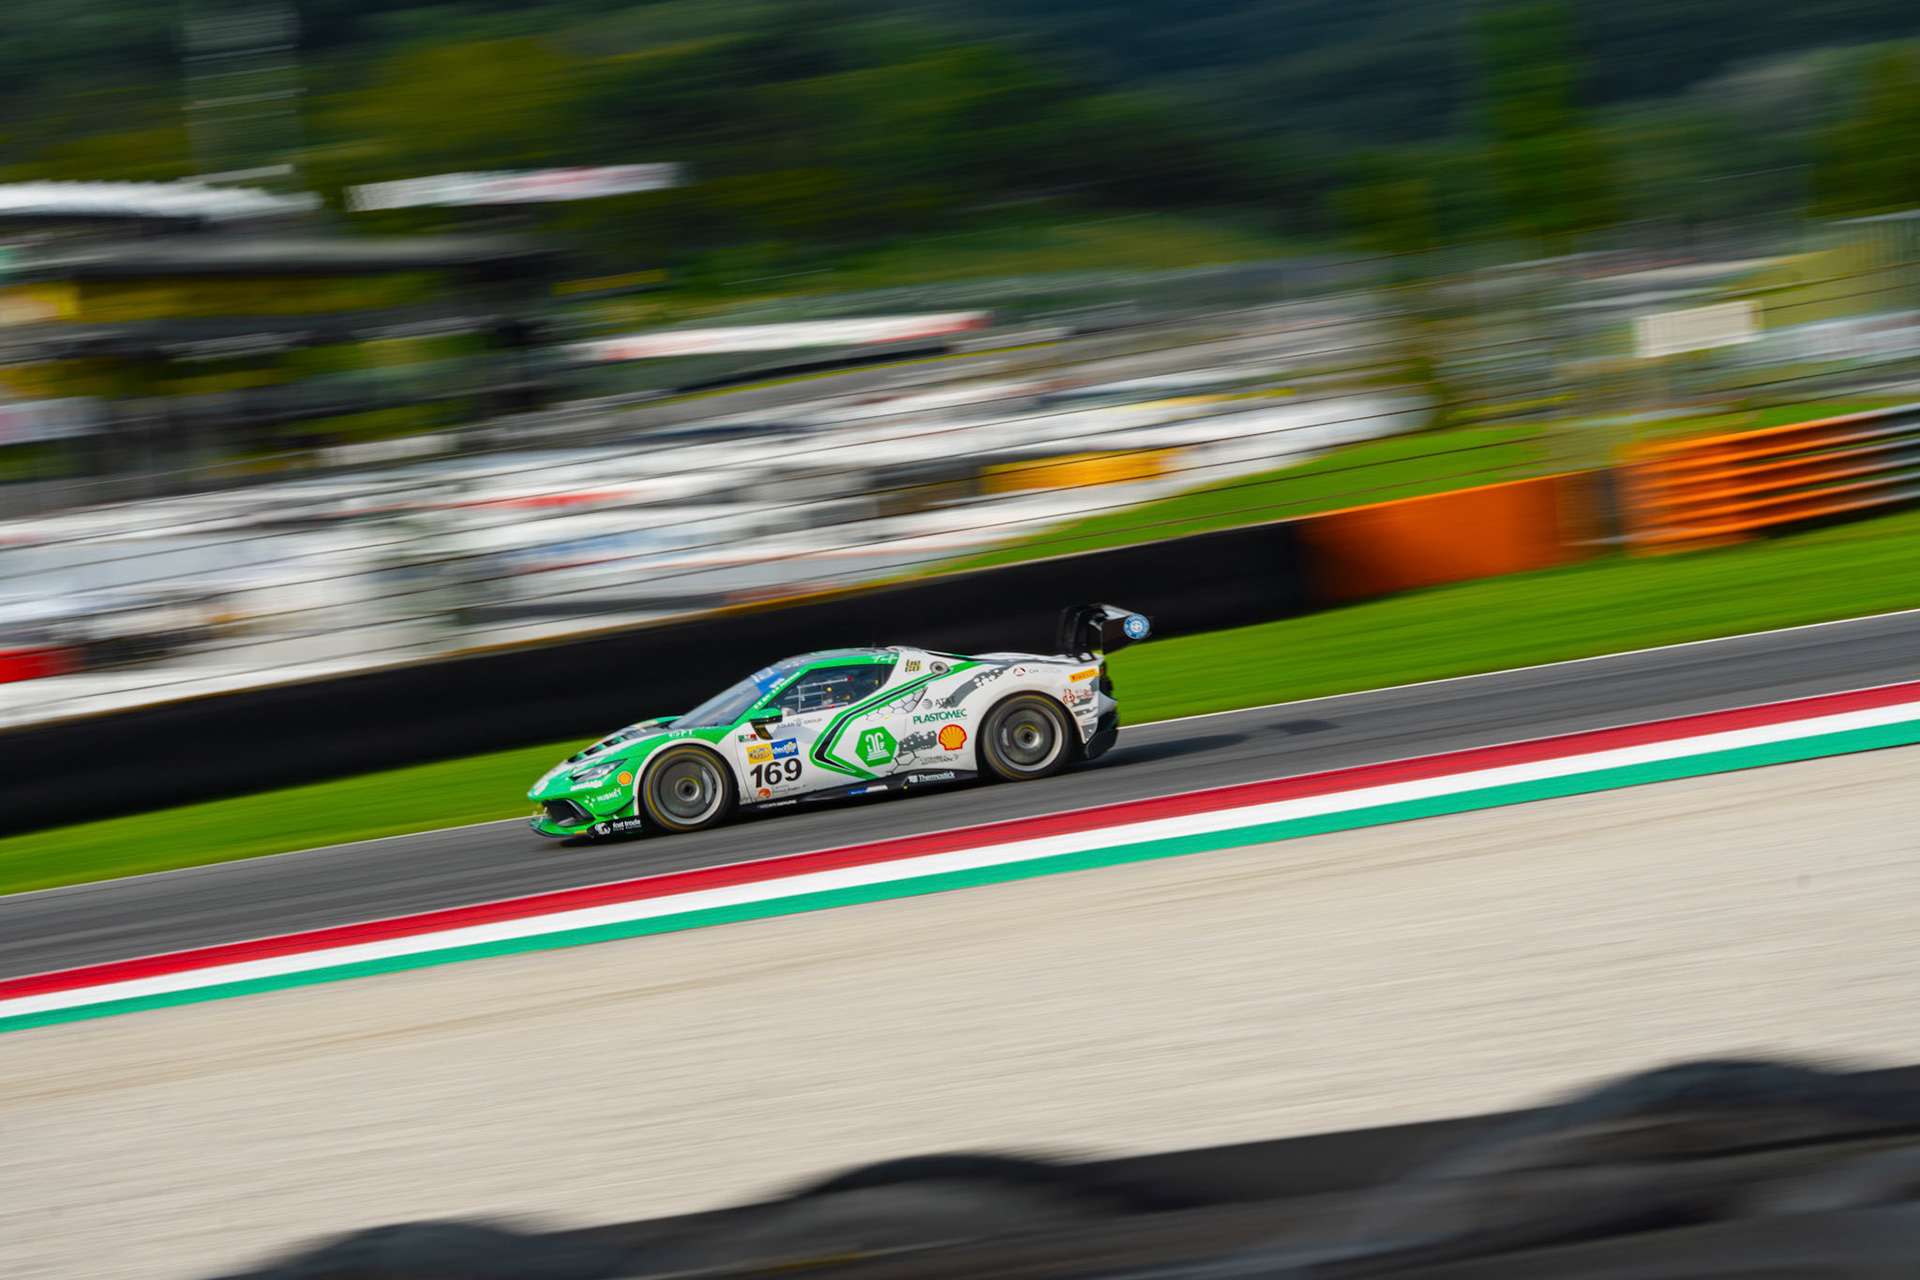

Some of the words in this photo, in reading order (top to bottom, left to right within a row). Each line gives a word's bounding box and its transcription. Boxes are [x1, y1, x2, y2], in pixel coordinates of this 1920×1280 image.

[934, 696, 956, 707] AT&T
[912, 708, 967, 725] PLASTOMEC
[750, 758, 802, 788] 169
